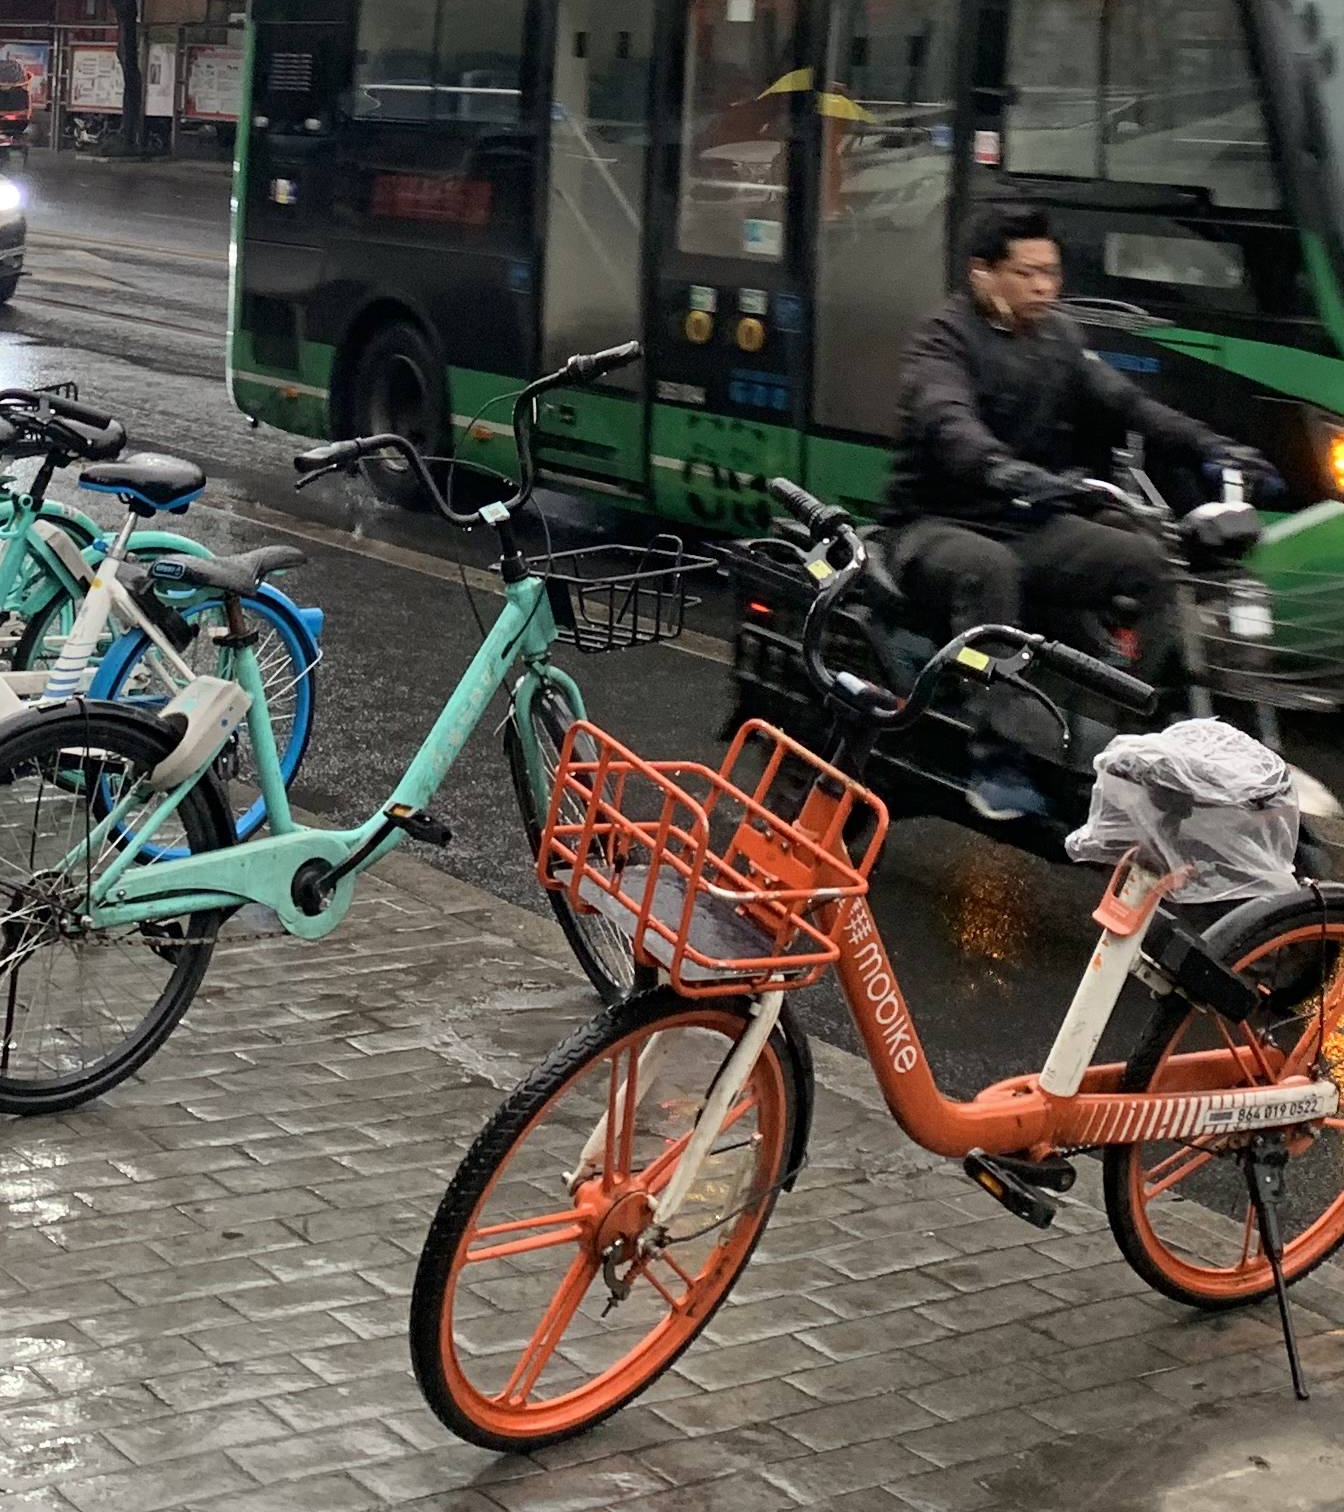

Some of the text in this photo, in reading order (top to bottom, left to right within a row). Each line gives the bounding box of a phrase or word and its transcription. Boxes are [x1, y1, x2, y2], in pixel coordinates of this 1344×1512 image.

[853, 942, 918, 1074] mobike
[1237, 1099, 1318, 1122] 864 019 0522
